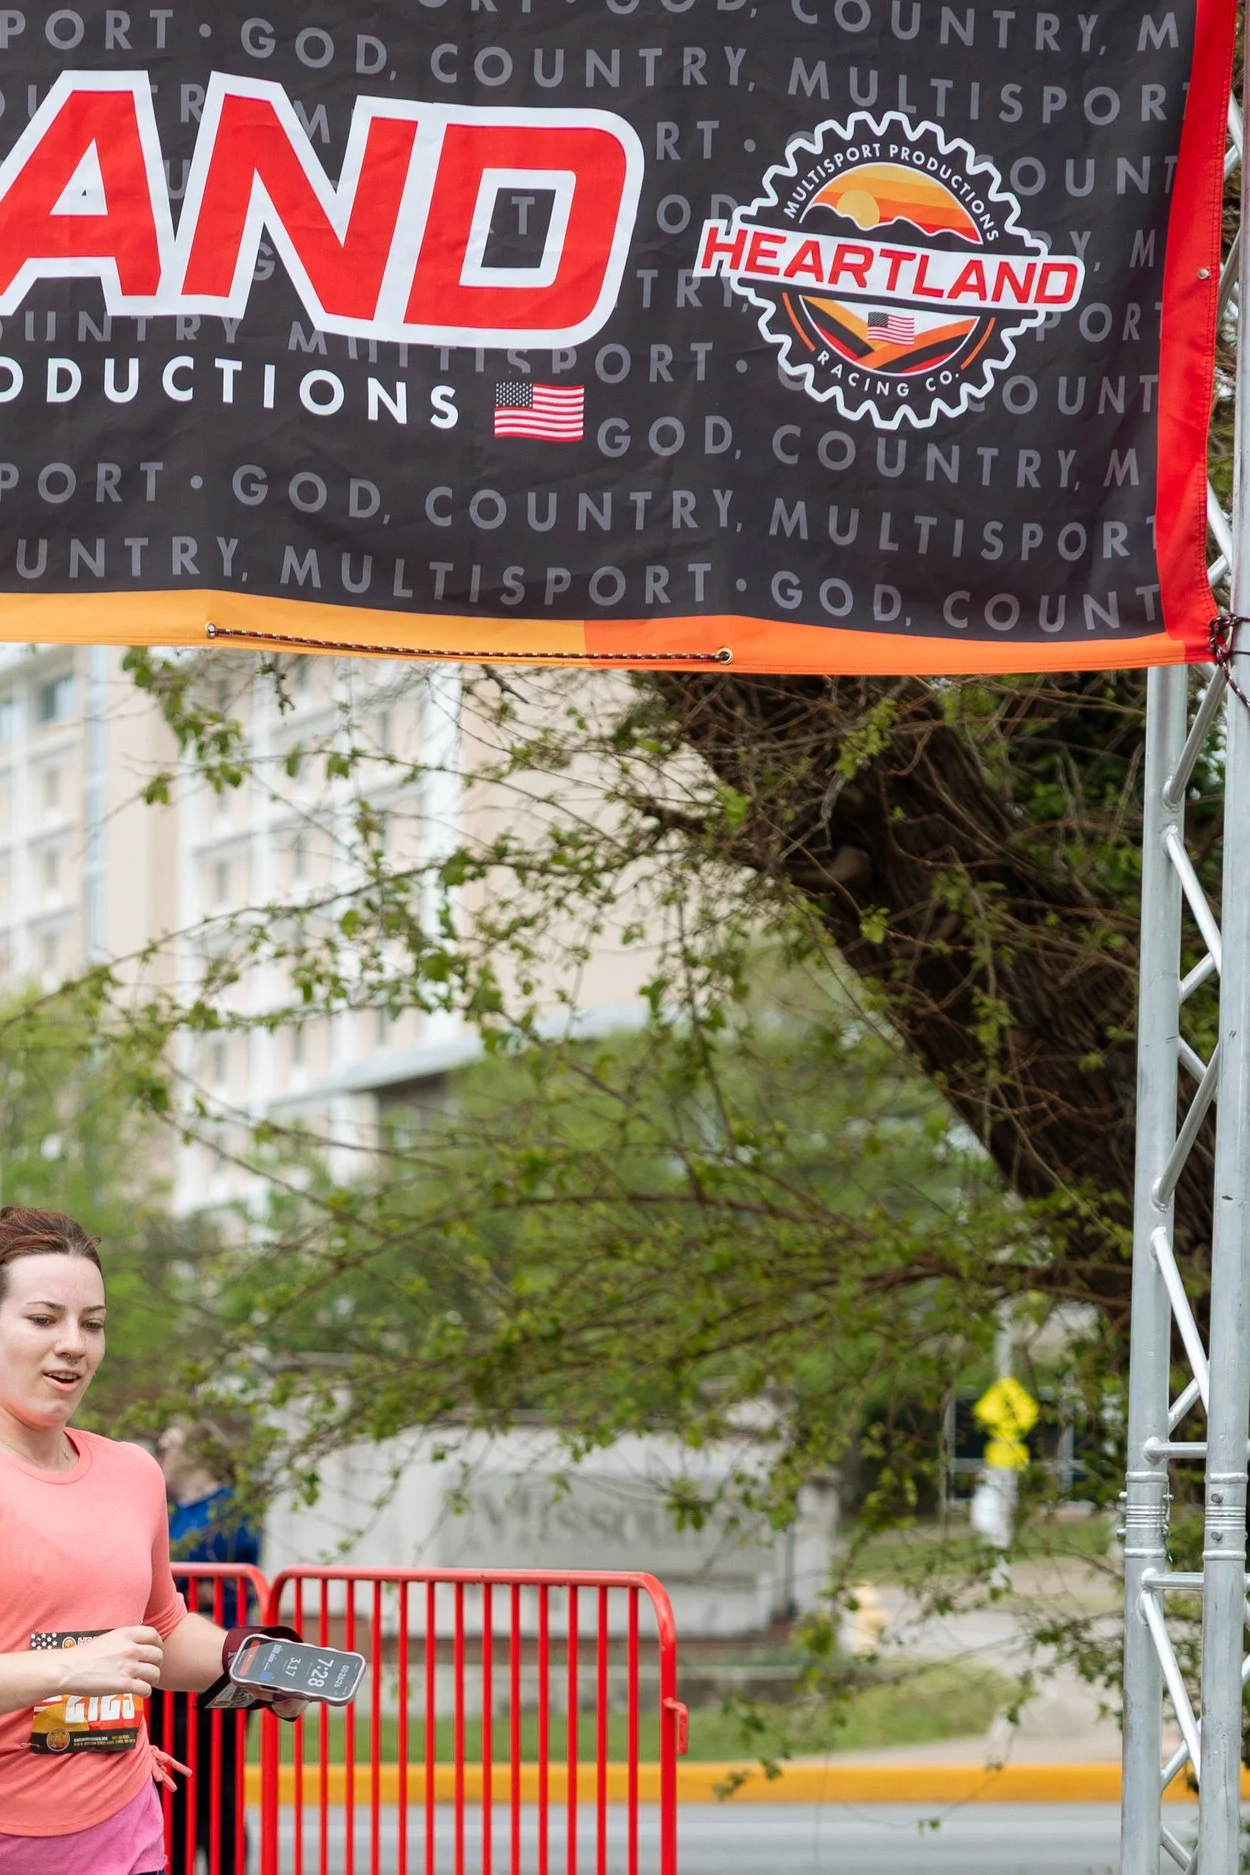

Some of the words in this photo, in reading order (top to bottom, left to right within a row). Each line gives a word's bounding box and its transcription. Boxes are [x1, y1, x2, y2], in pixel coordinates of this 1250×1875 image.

[792, 0, 1106, 55] COUNTRY,
[241, 18, 397, 81] GOD,
[431, 43, 755, 92] COUNTRY,
[788, 57, 1191, 125] MULTISPOR
[783, 143, 881, 219] MULTISPORT
[889, 144, 999, 242] PRODUCTIONS
[700, 226, 1079, 305] HEARTLAND
[817, 350, 909, 397] RACING
[925, 370, 960, 392] CO.
[597, 416, 742, 460] GOD,
[773, 425, 1081, 492] COUNTRY,
[232, 465, 390, 525] GOD,
[425, 486, 742, 533] COUNTRY,
[769, 498, 1156, 560] MULTISPOR
[280, 546, 711, 606] MULTISPORT
[771, 571, 912, 627] GOD,
[285, 1657, 302, 1677] 3.17
[307, 1658, 335, 1688] 7:28
